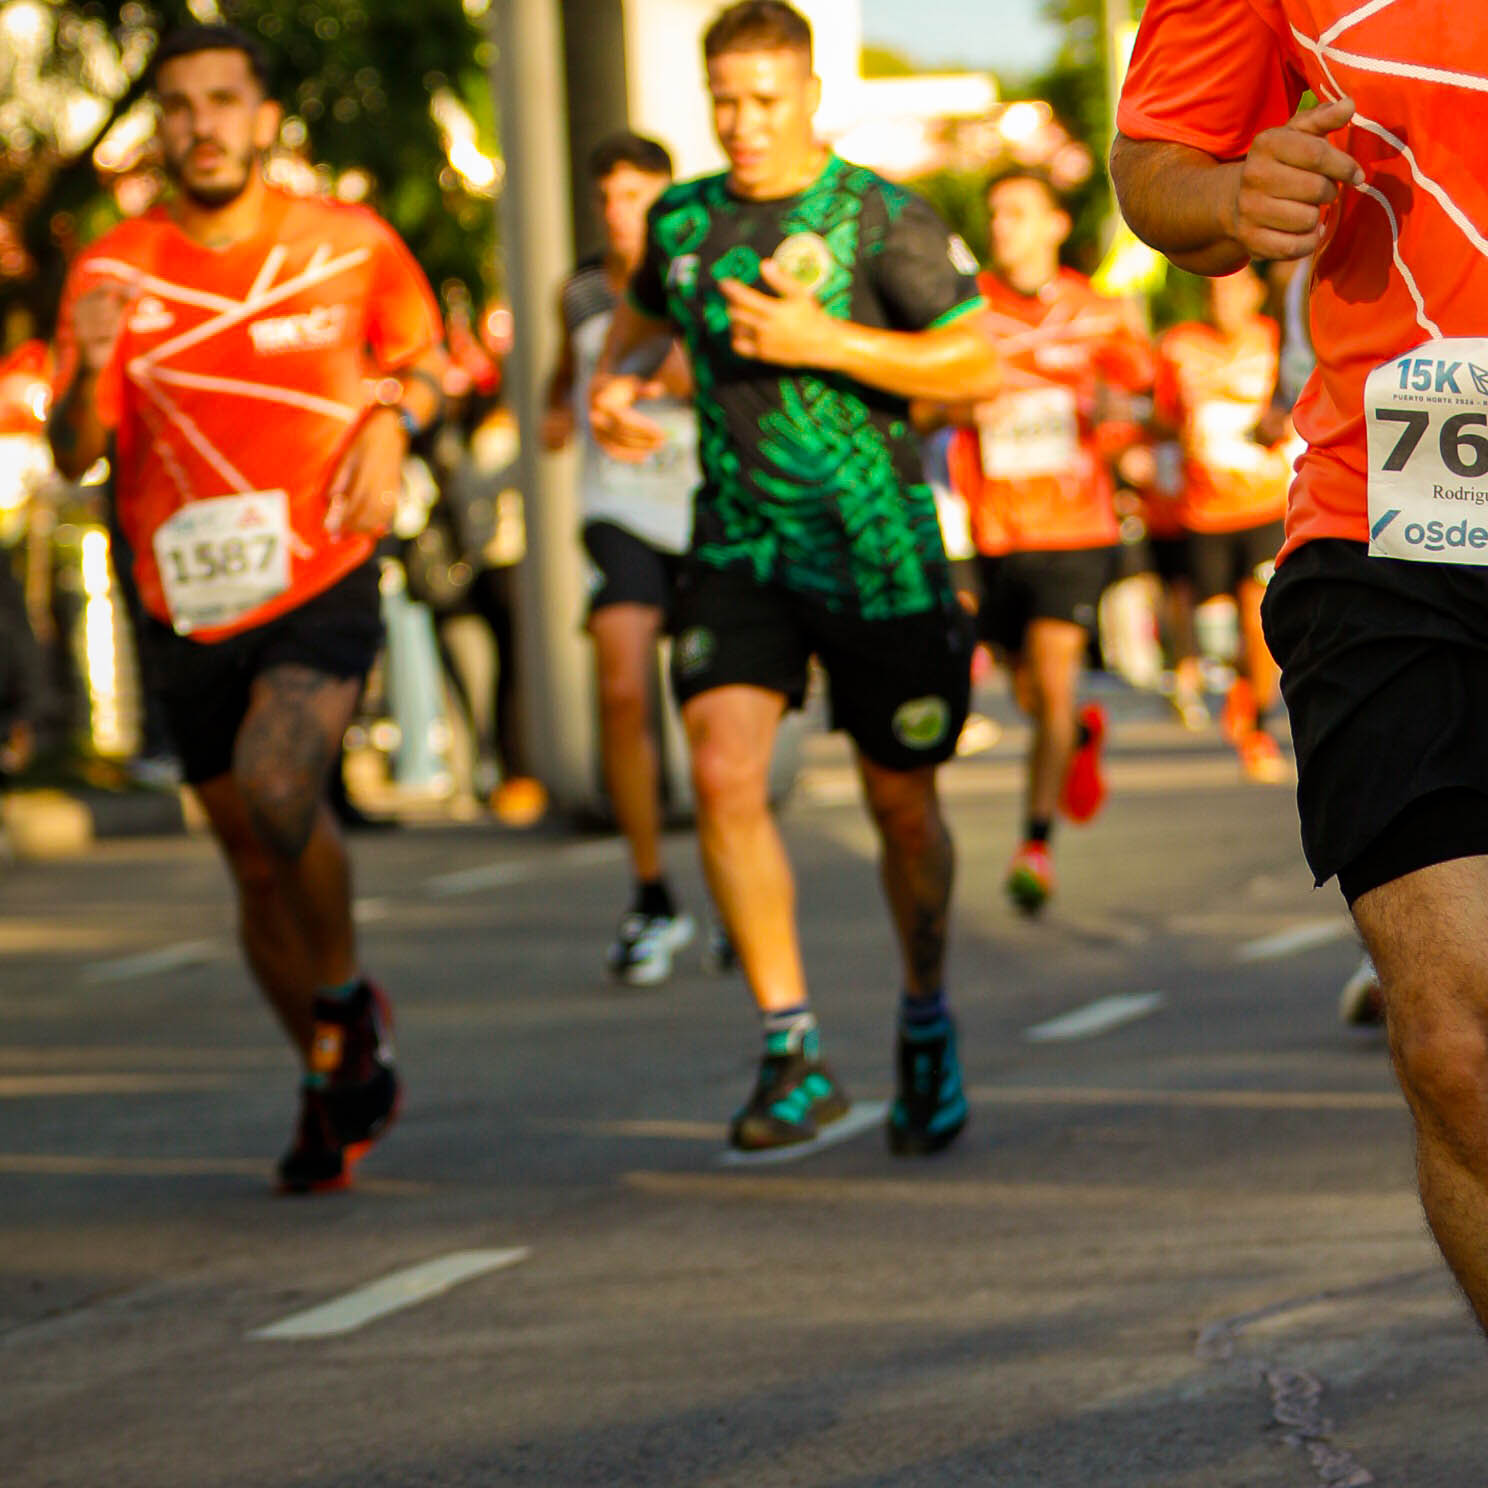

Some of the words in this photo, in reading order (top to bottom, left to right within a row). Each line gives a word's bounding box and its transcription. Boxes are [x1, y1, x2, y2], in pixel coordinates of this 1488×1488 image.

[1397, 358, 1462, 393] 15K
[1392, 394, 1424, 402] PUERTO
[1404, 518, 1488, 550] osde
[167, 533, 279, 584] 1587
